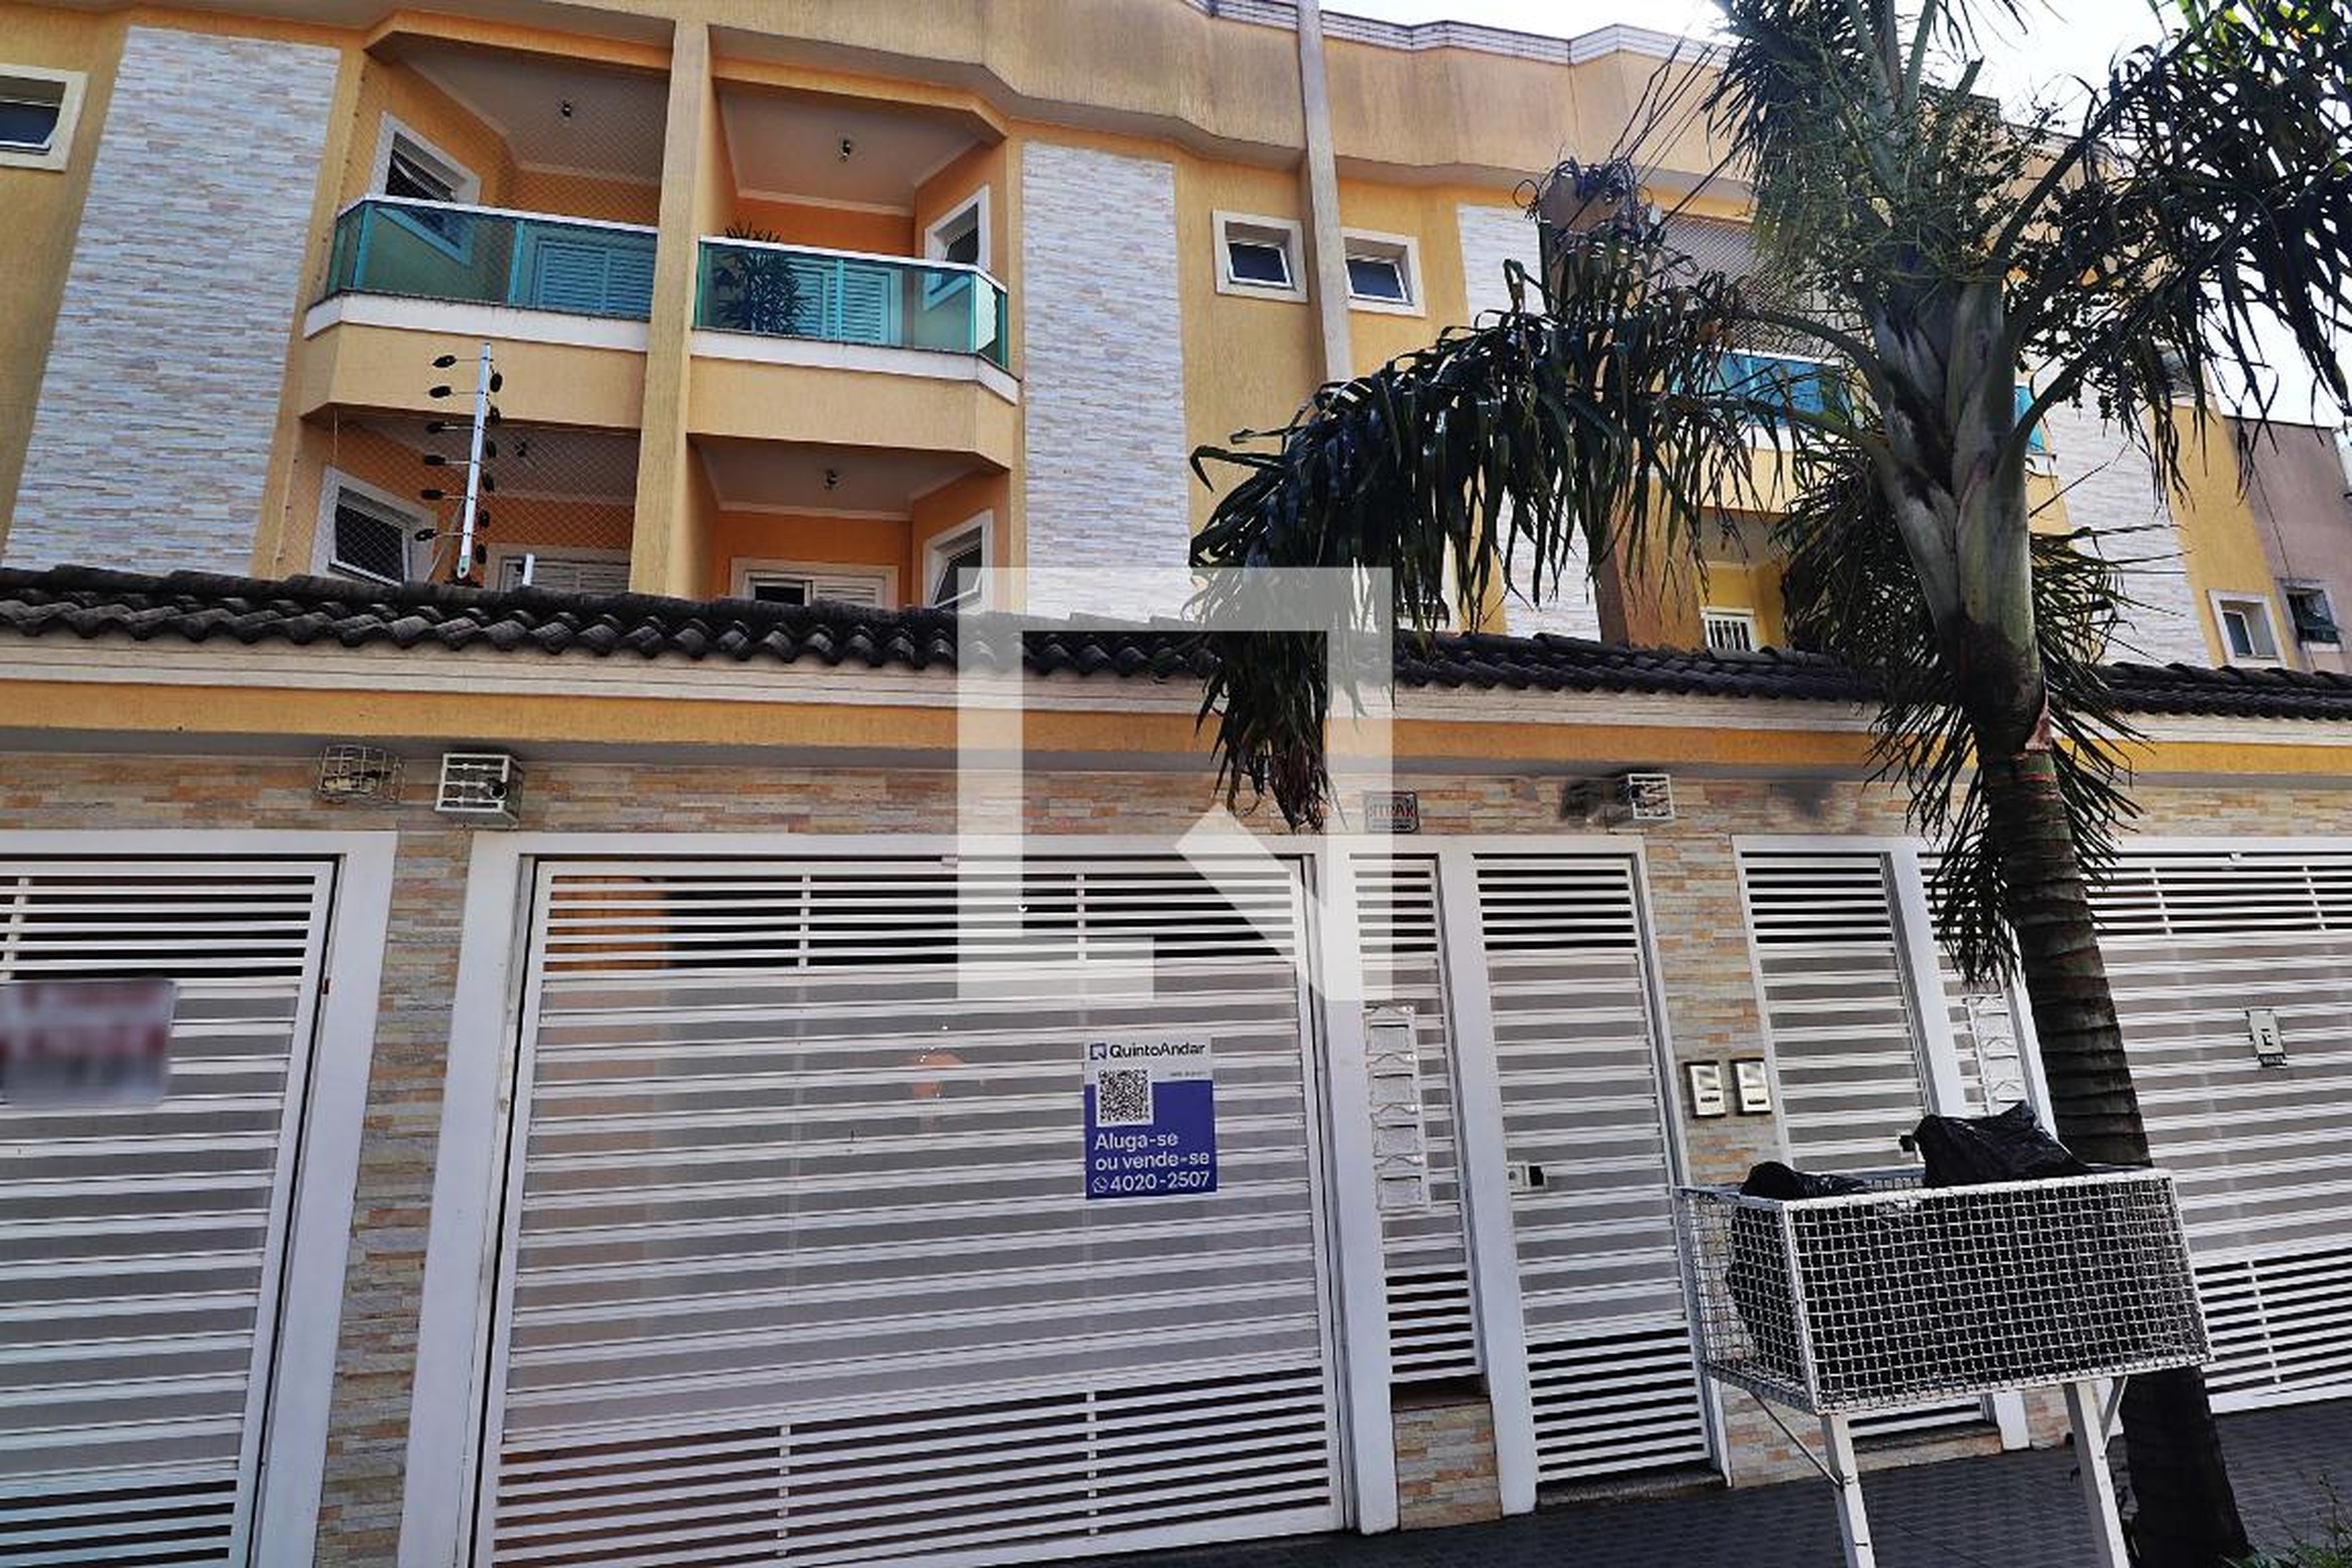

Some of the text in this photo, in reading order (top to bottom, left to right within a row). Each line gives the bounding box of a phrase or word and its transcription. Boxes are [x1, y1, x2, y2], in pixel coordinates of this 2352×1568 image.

[1109, 1042, 1205, 1058] QuintoAndar
[1094, 1133, 1178, 1152] Aluga-se
[1095, 1152, 1210, 1170] ou vende-se
[1110, 1170, 1210, 1191] 4020-2507
